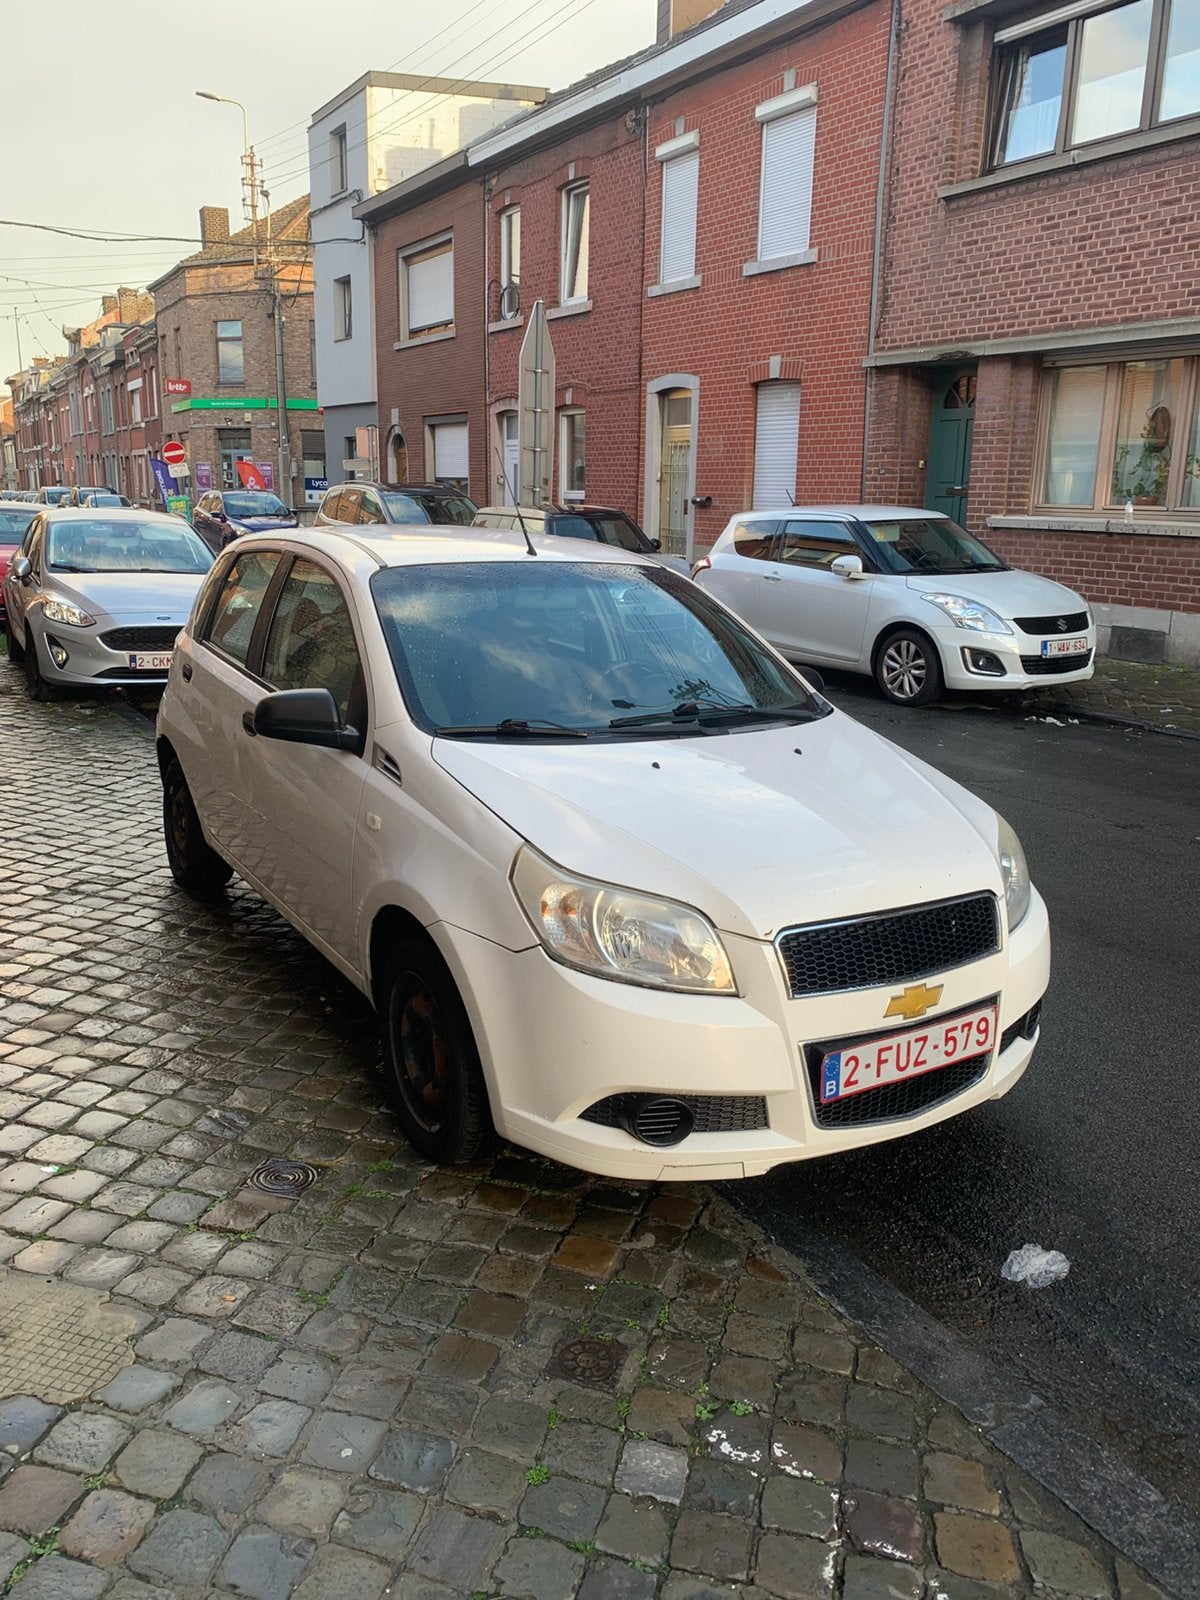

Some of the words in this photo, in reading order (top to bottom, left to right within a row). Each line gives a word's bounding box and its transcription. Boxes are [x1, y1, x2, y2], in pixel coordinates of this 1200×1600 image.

[1049, 640, 1086, 653] 1-WAW-634
[843, 1016, 989, 1088] 2-FUZ-579
[825, 1080, 837, 1098] B
